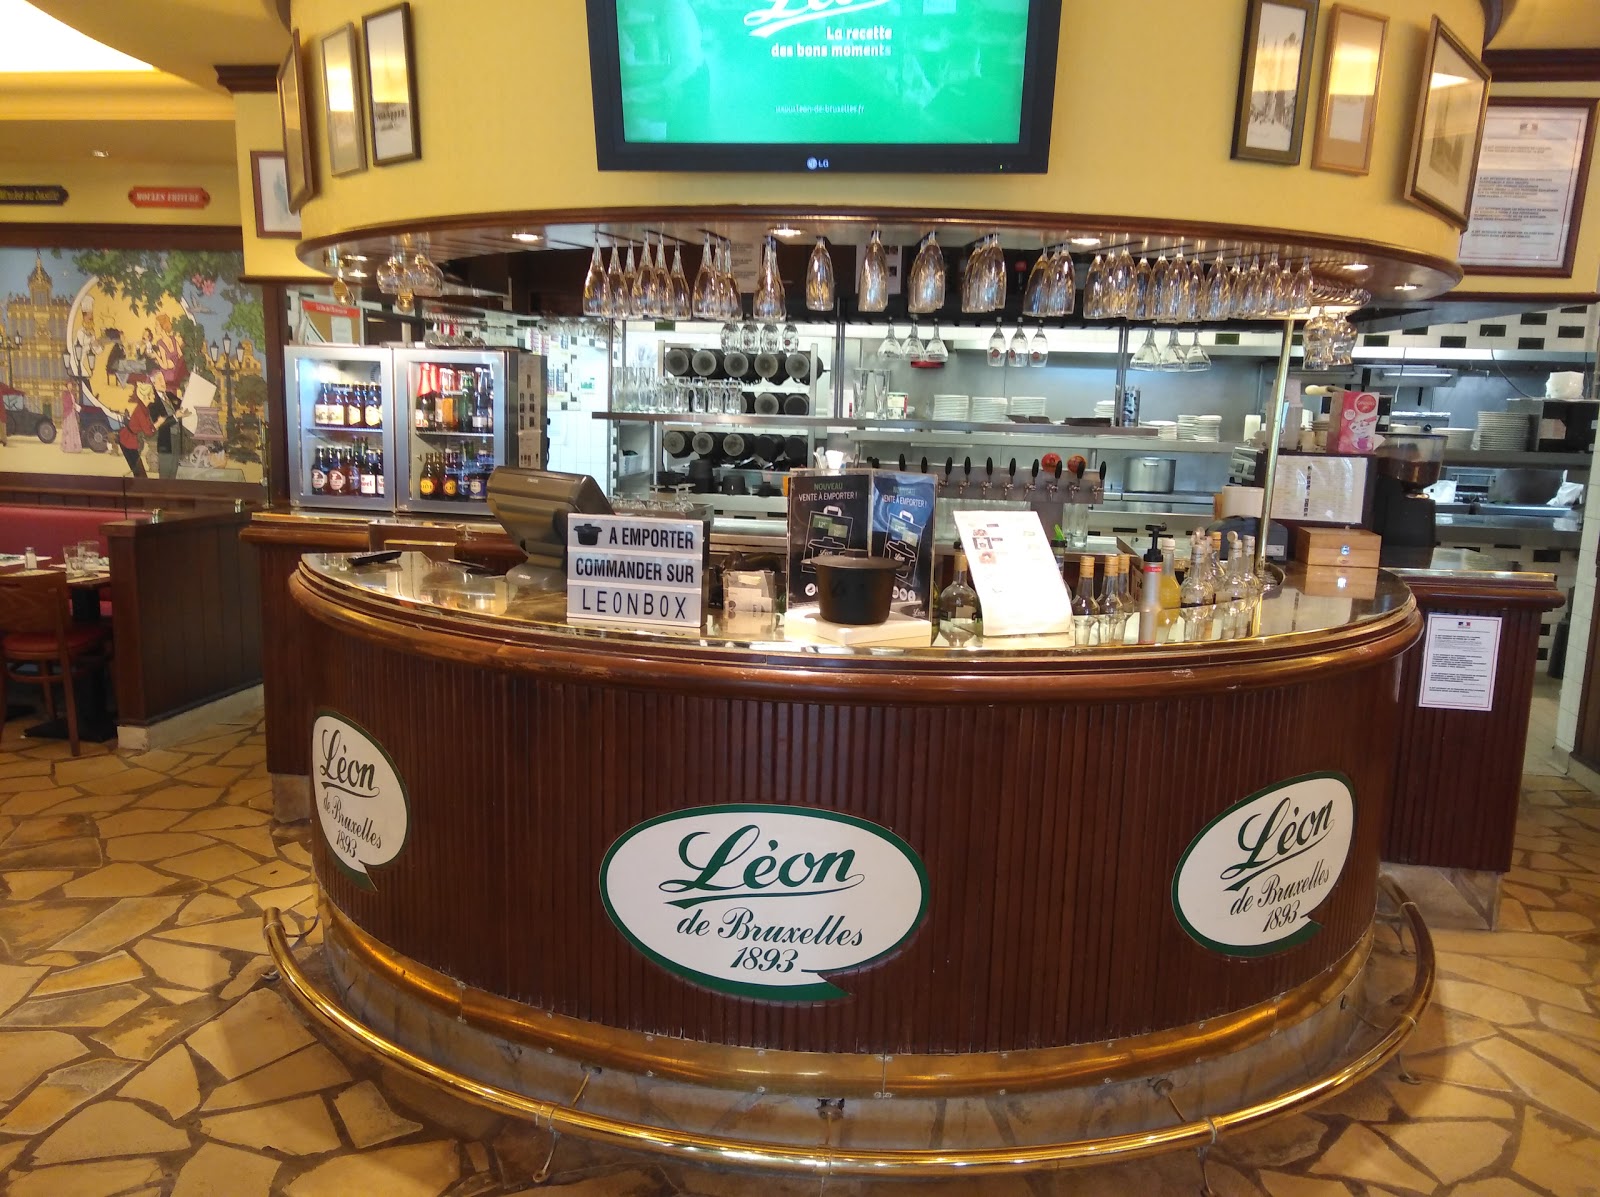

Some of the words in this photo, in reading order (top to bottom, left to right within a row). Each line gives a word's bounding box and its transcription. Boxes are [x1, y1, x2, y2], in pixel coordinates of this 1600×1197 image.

[826, 26, 843, 40] La
[846, 25, 893, 40] recette
[771, 43, 794, 58] des
[797, 43, 828, 58] bons
[831, 43, 892, 57] moments
[818, 158, 829, 168] LG
[798, 493, 817, 502] VENTE
[823, 491, 854, 501] EMPORTER
[813, 482, 843, 491] NOUVEAU
[899, 496, 924, 507] EMPORTER
[609, 526, 619, 545] A
[621, 527, 694, 549] EMPORTER
[575, 557, 662, 581] COMMANDER
[666, 563, 694, 583] SUR
[582, 588, 687, 619] LEONBOX
[323, 792, 332, 814] de
[332, 795, 382, 849] Bruxelles
[336, 829, 358, 858] 1893
[1229, 885, 1254, 916] de
[1257, 857, 1331, 908] Bruxelles
[676, 908, 711, 937] de
[716, 906, 864, 948] Bruxelles
[1262, 899, 1301, 933] 1893
[729, 946, 800, 974] 1893
